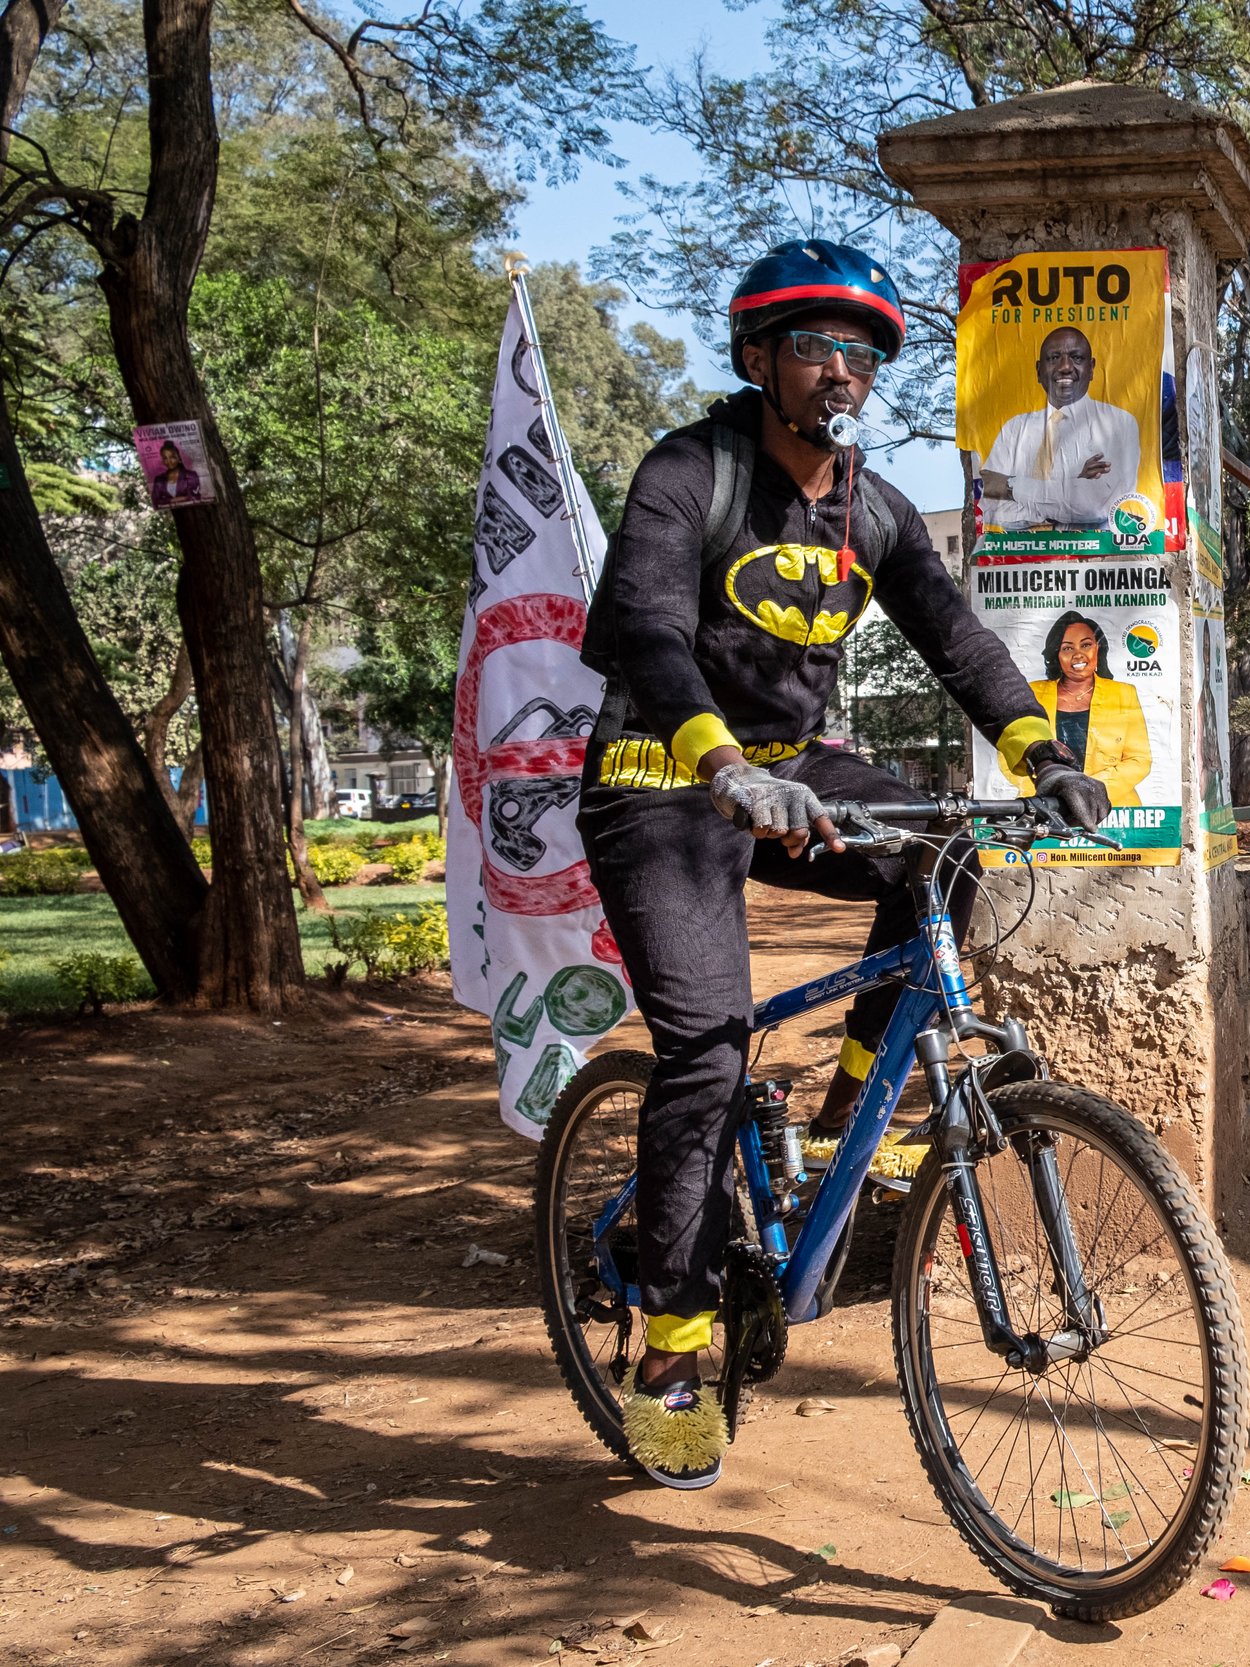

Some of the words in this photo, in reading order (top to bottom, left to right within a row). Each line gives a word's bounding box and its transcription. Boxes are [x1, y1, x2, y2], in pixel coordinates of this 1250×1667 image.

[992, 264, 1131, 307] RUTO
[992, 308, 1022, 324] FOR
[1033, 305, 1130, 323] PRESIDENT
[168, 423, 197, 434] OWINO
[1003, 540, 1046, 551] HUSTLE
[1049, 540, 1100, 551] MATTERS
[1113, 534, 1150, 546] UDA
[977, 569, 1080, 594] MILLICENT
[1085, 567, 1172, 591] OMANGA
[984, 596, 1020, 610] MAMA
[1023, 595, 1066, 609] MIRADI
[1075, 594, 1113, 608] MAMA
[1114, 593, 1167, 607] KANAIRO
[1125, 620, 1155, 632] DEMOCRATIC
[1127, 660, 1162, 671] UDA
[1133, 809, 1166, 829] REP
[1050, 853, 1068, 862] Hon.
[1070, 852, 1106, 862] Millicent
[1107, 852, 1142, 863] Omanga
[840, 976, 864, 989] SYSTEM
